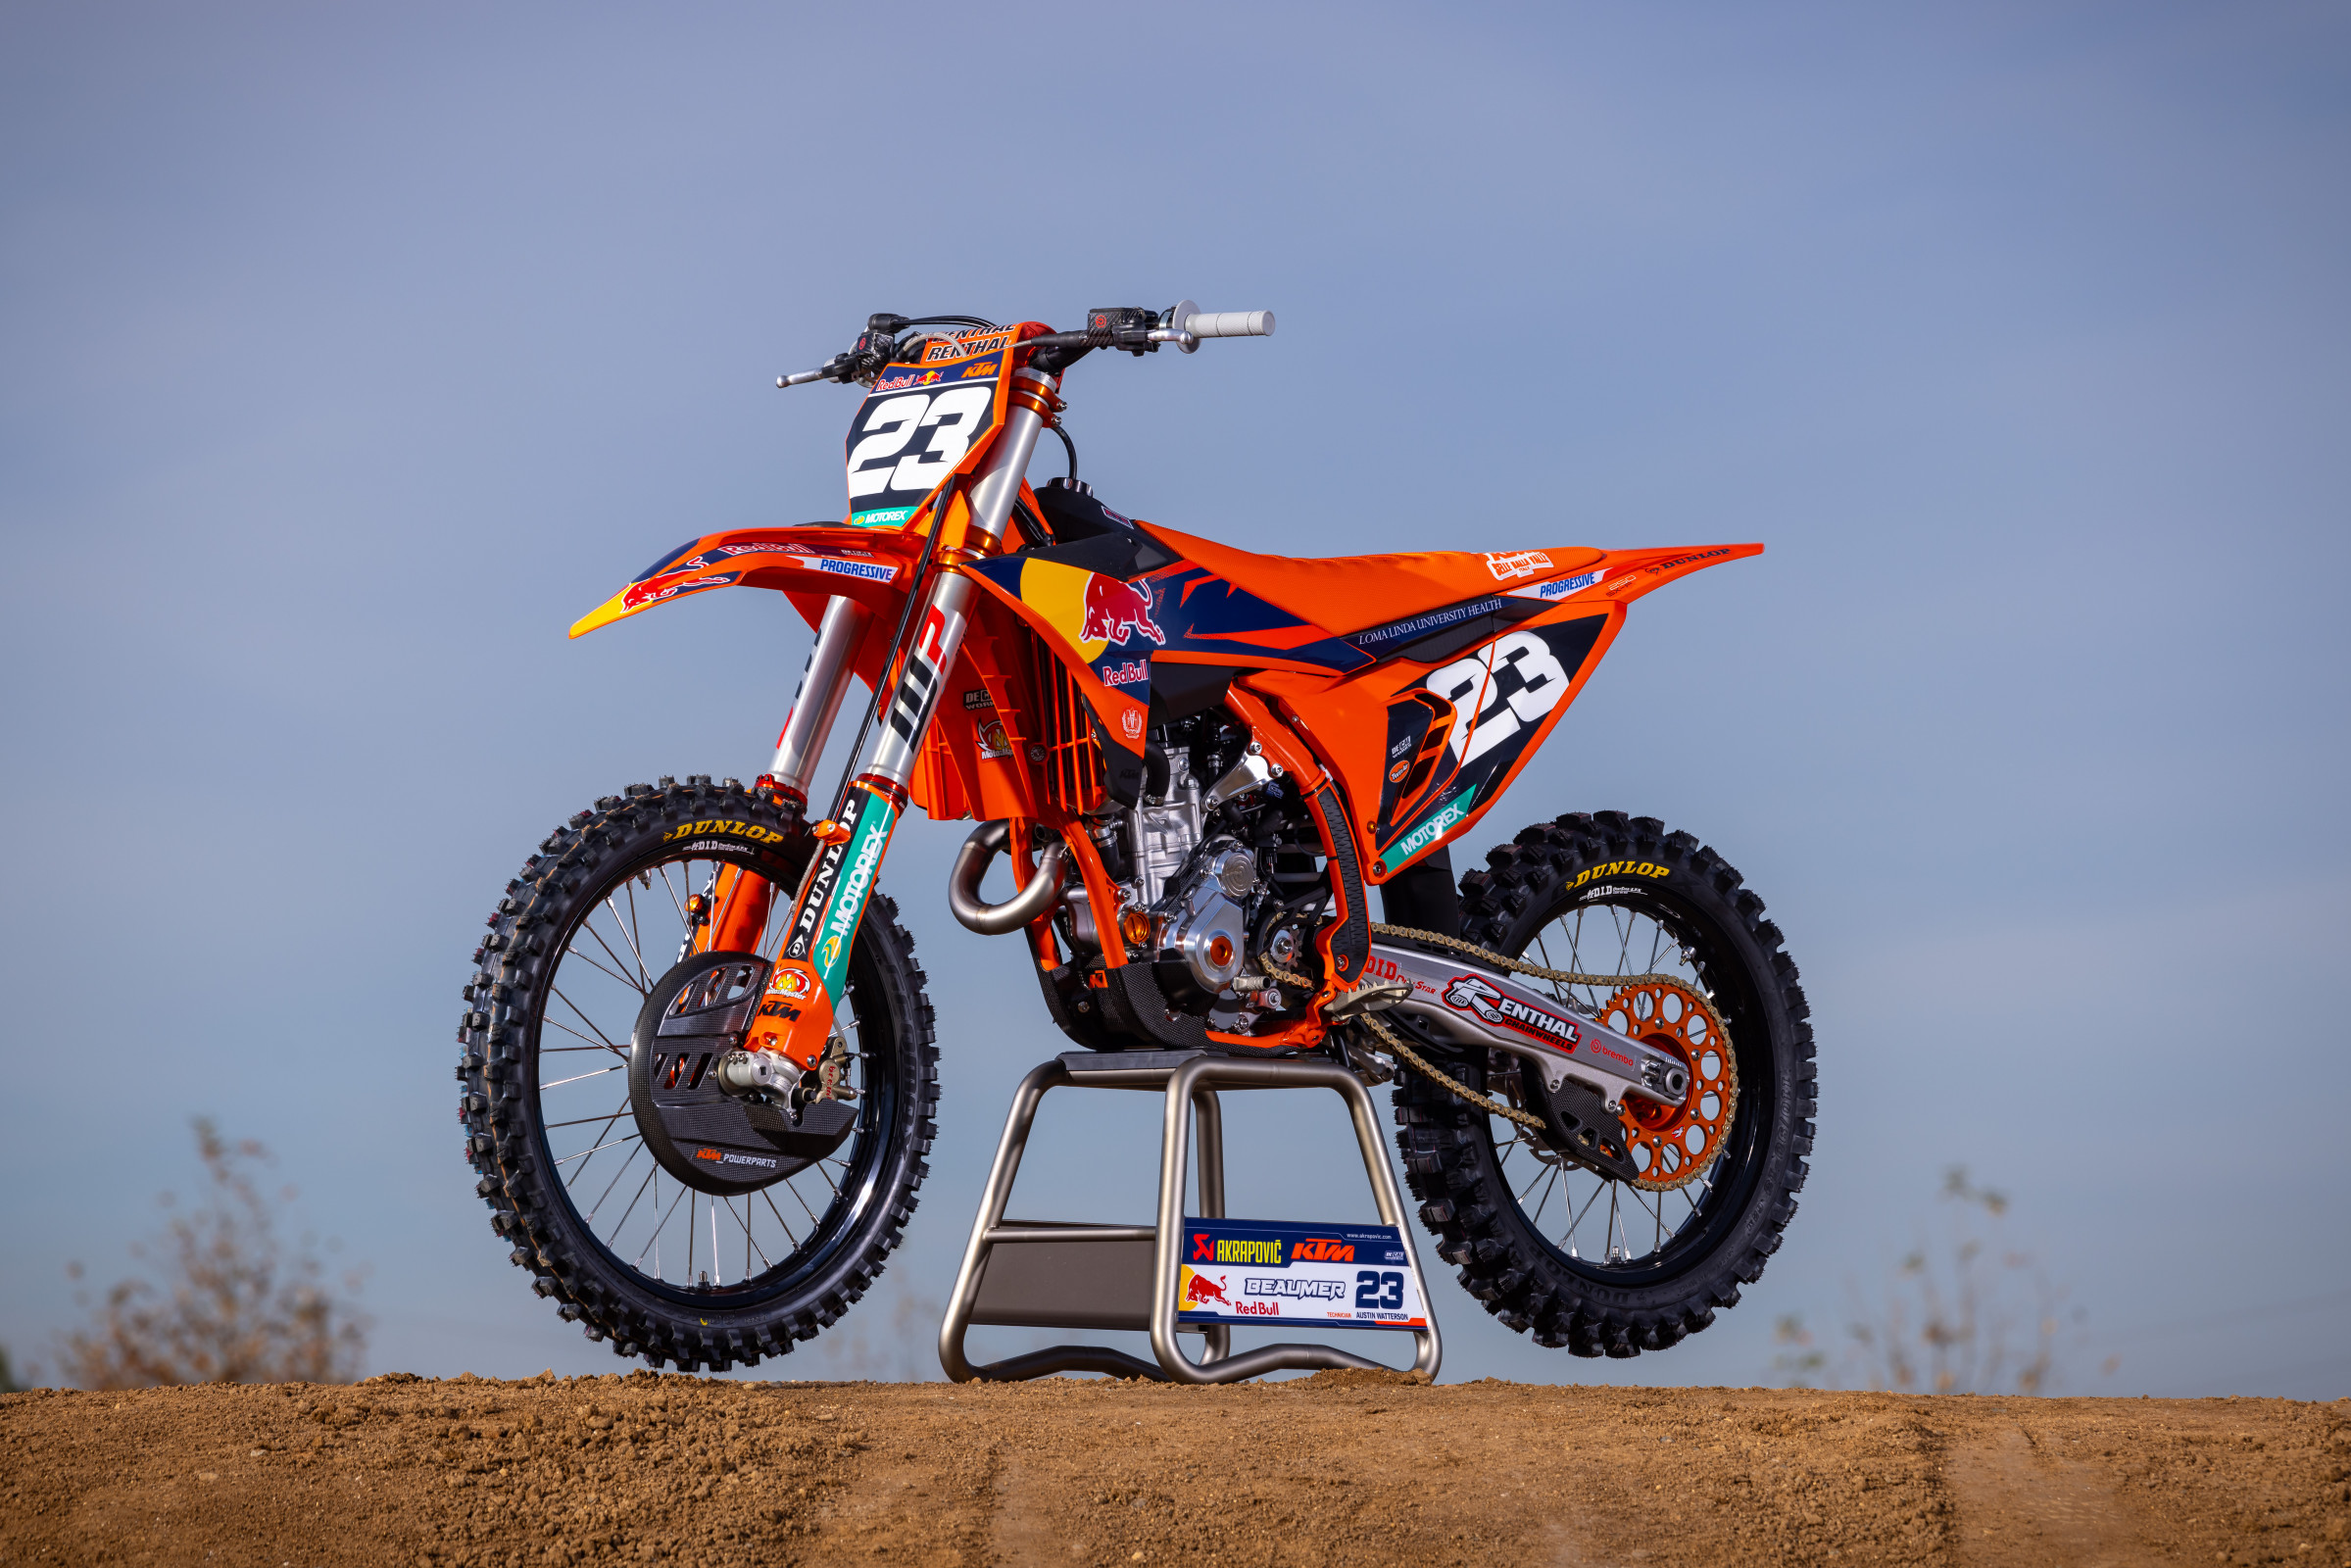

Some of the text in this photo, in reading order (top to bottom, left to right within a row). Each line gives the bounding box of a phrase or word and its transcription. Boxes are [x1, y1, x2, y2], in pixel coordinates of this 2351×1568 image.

[925, 335, 1010, 362] RENTHAL
[876, 373, 915, 391] Red Bull
[961, 362, 998, 378] KTM
[847, 386, 992, 499] 23
[864, 511, 907, 523] MOTOREX
[819, 559, 893, 581] PROGRESSIVE
[1660, 548, 1732, 569] DUNLOP
[1540, 572, 1595, 598] PROGRESSIVE
[1608, 574, 1637, 591] 250
[1359, 598, 1502, 645] LOMA LINDA UNIVERSITY HEALTH
[1102, 659, 1150, 686] Red Bull
[1426, 630, 1570, 768] 23
[672, 819, 784, 844] DUNLOP
[1399, 802, 1464, 857] MOTOREX
[830, 822, 889, 936] MOTOREX
[1574, 860, 1670, 888] DUNLOP
[757, 1001, 802, 1022] KTM
[1446, 978, 1580, 1042] RENTHAL
[1504, 1017, 1573, 1051] CHAINWHEELS
[1601, 1045, 1634, 1066] brembo
[826, 1066, 836, 1100] brem
[697, 1148, 721, 1161] KTM
[1291, 1238, 1355, 1262] KTM
[1245, 1278, 1346, 1301] BEAUMER
[1355, 1270, 1404, 1310] 23
[1236, 1300, 1280, 1316] Red Bull
